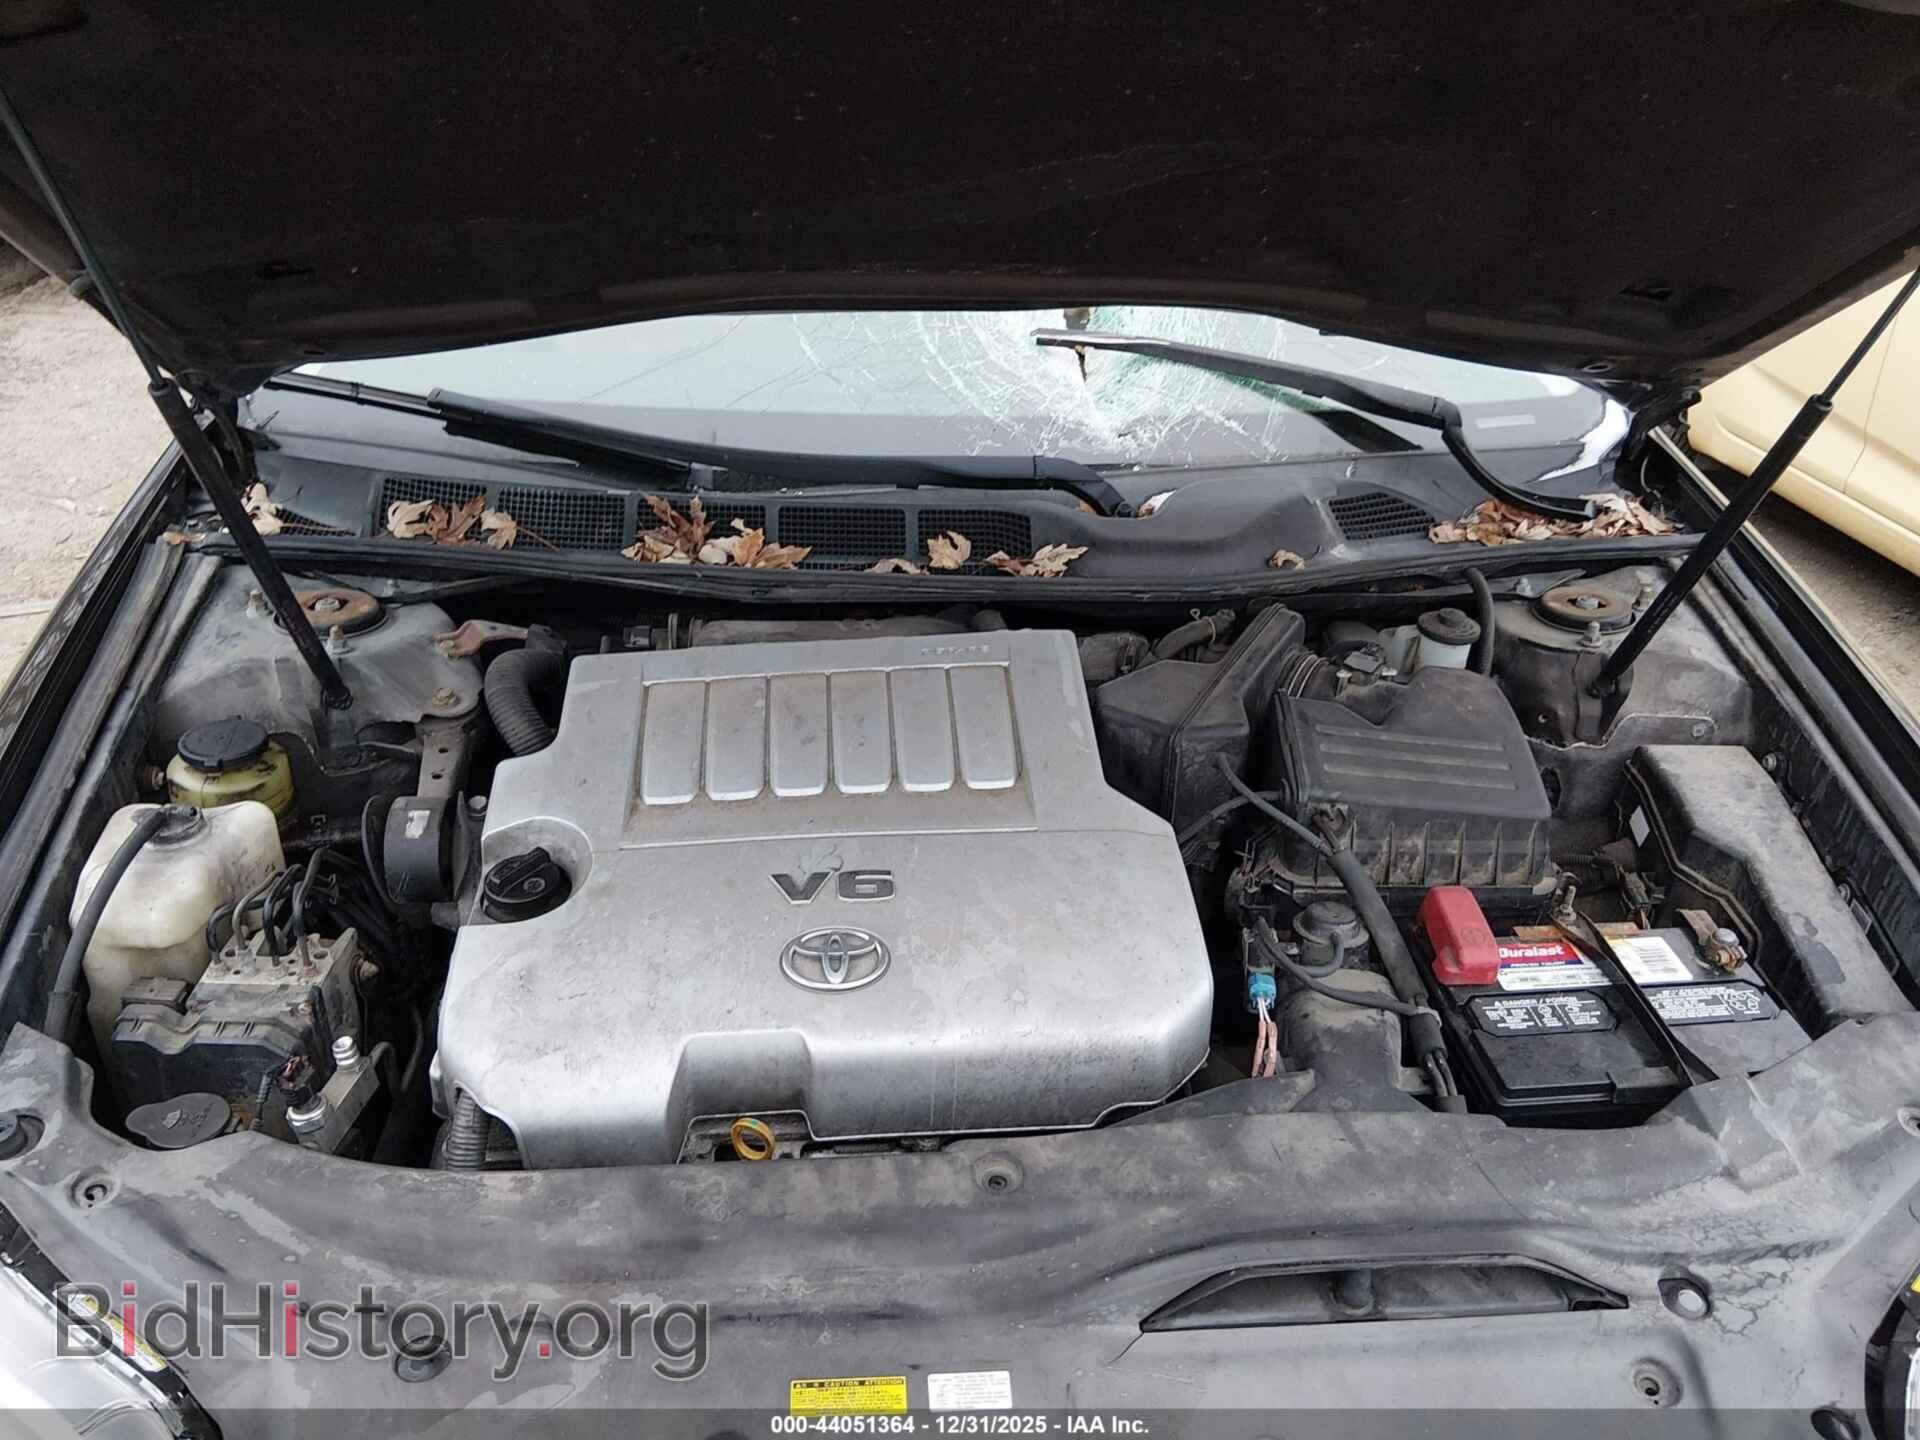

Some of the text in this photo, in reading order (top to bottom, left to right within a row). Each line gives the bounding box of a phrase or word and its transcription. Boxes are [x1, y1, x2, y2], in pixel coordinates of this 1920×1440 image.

[769, 870, 896, 905] V6
[1498, 945, 1565, 959] Duralast
[824, 1380, 859, 1388] CAUTION
